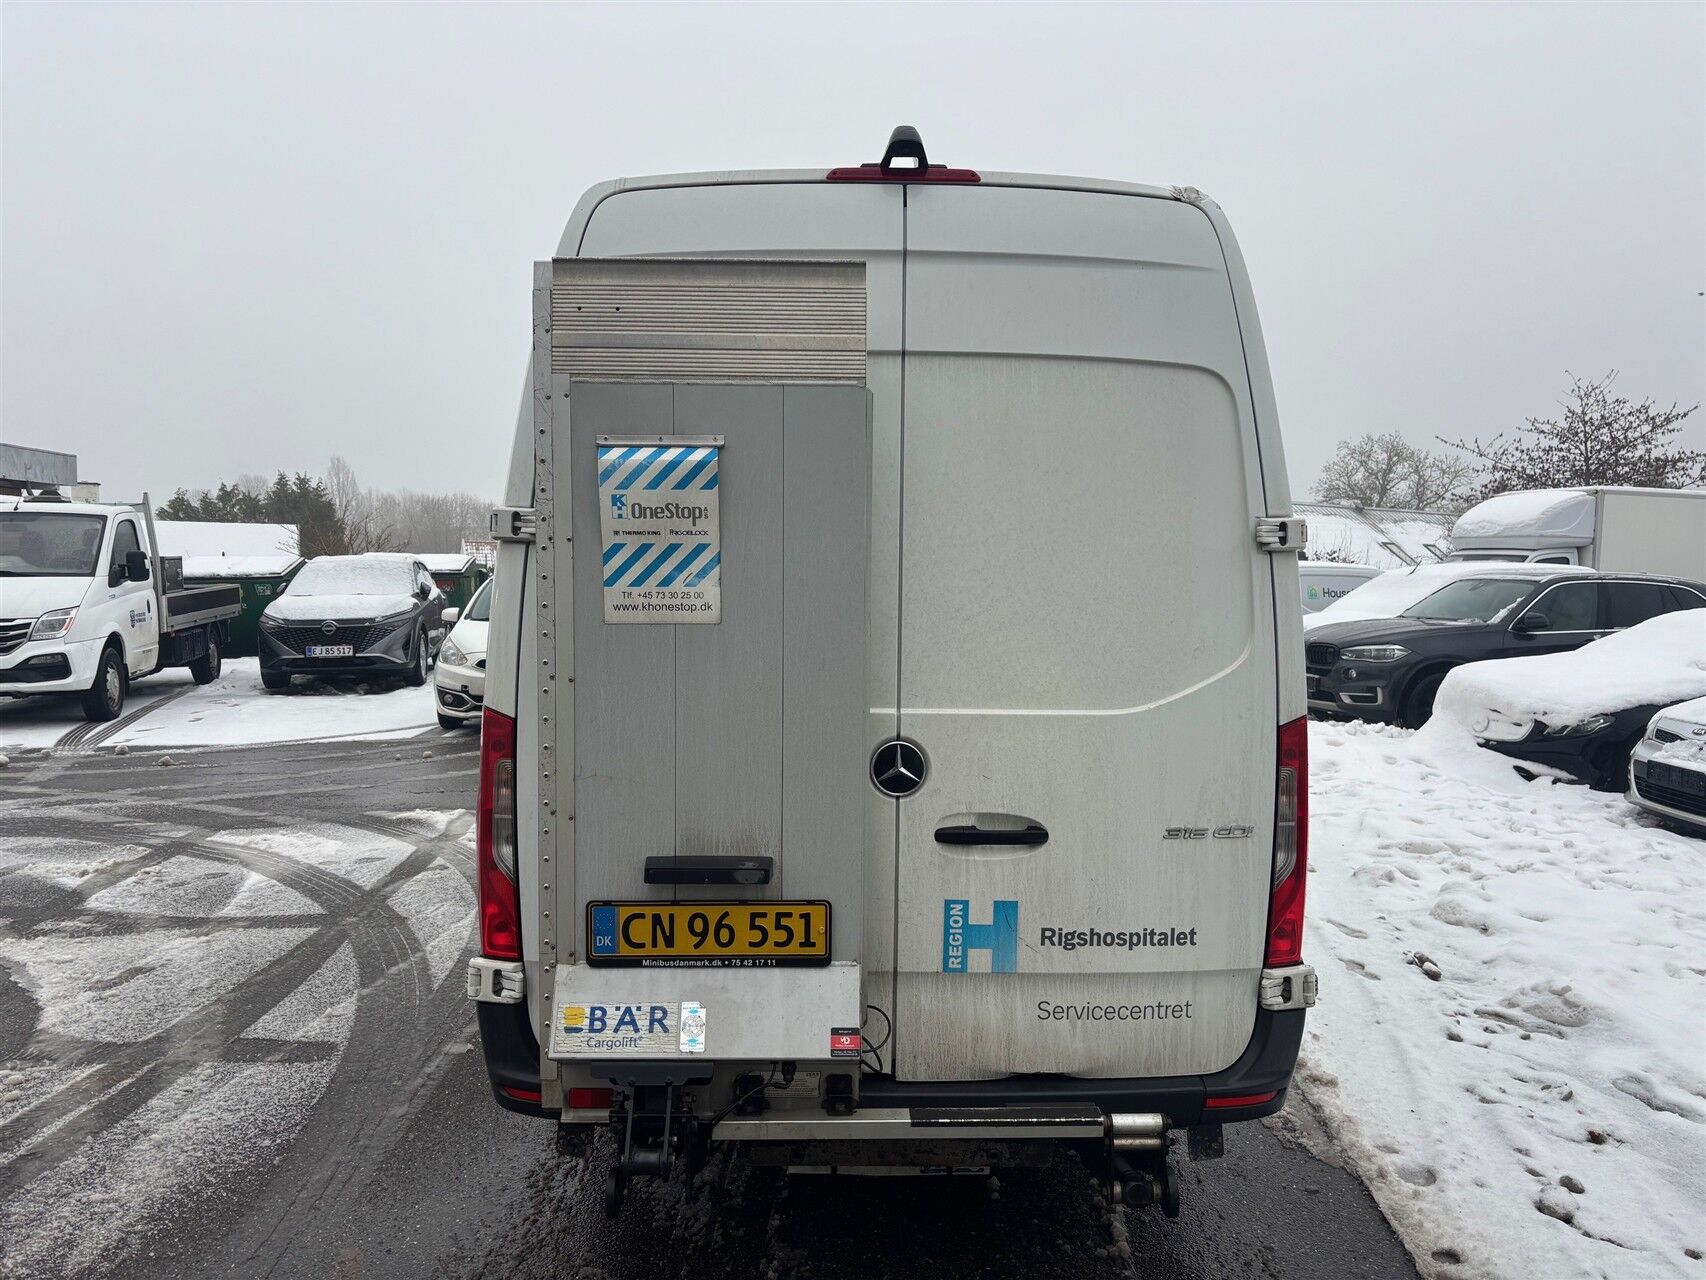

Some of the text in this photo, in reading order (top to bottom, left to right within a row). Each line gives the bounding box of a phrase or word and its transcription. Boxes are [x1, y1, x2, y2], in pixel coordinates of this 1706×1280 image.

[631, 502, 703, 526] OneStop
[621, 592, 704, 600] Tlf. +45 73 30 25 00
[613, 602, 713, 613] www.khonestop.dk
[312, 647, 352, 655] EJ 85 517
[596, 911, 817, 950] DK CN 96 551
[948, 903, 964, 968] REGION
[1040, 927, 1197, 951] Rigshospitalet
[642, 958, 777, 967] Minibusdanmark.dk 75 42 17 11
[588, 1005, 670, 1034] BÄR
[1036, 1001, 1192, 1021] Servicecentret
